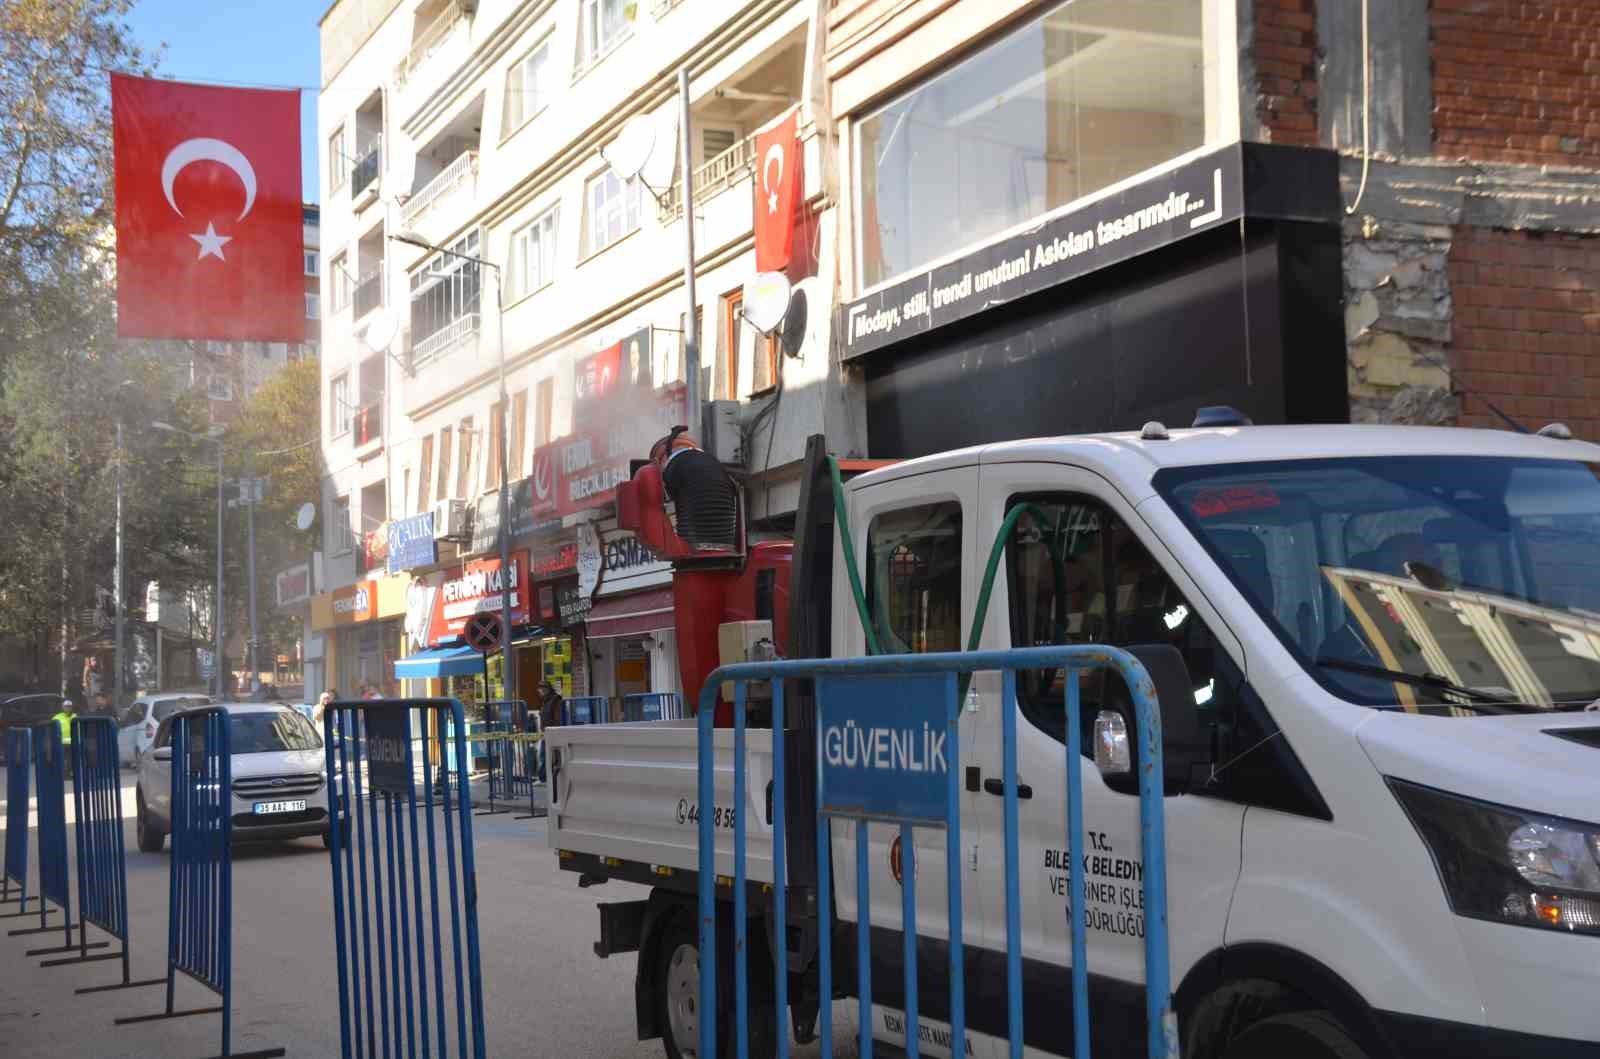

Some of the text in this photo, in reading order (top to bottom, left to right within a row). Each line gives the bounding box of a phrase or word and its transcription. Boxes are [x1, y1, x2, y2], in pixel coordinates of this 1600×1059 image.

[933, 273, 971, 310] trendi
[607, 537, 656, 571] OSMA
[825, 719, 947, 774] GÜVENLİK
[1088, 831, 1112, 851] T.C.
[1045, 849, 1144, 881] BİLEK BELEDİY
[1119, 886, 1145, 909] İŞLE
